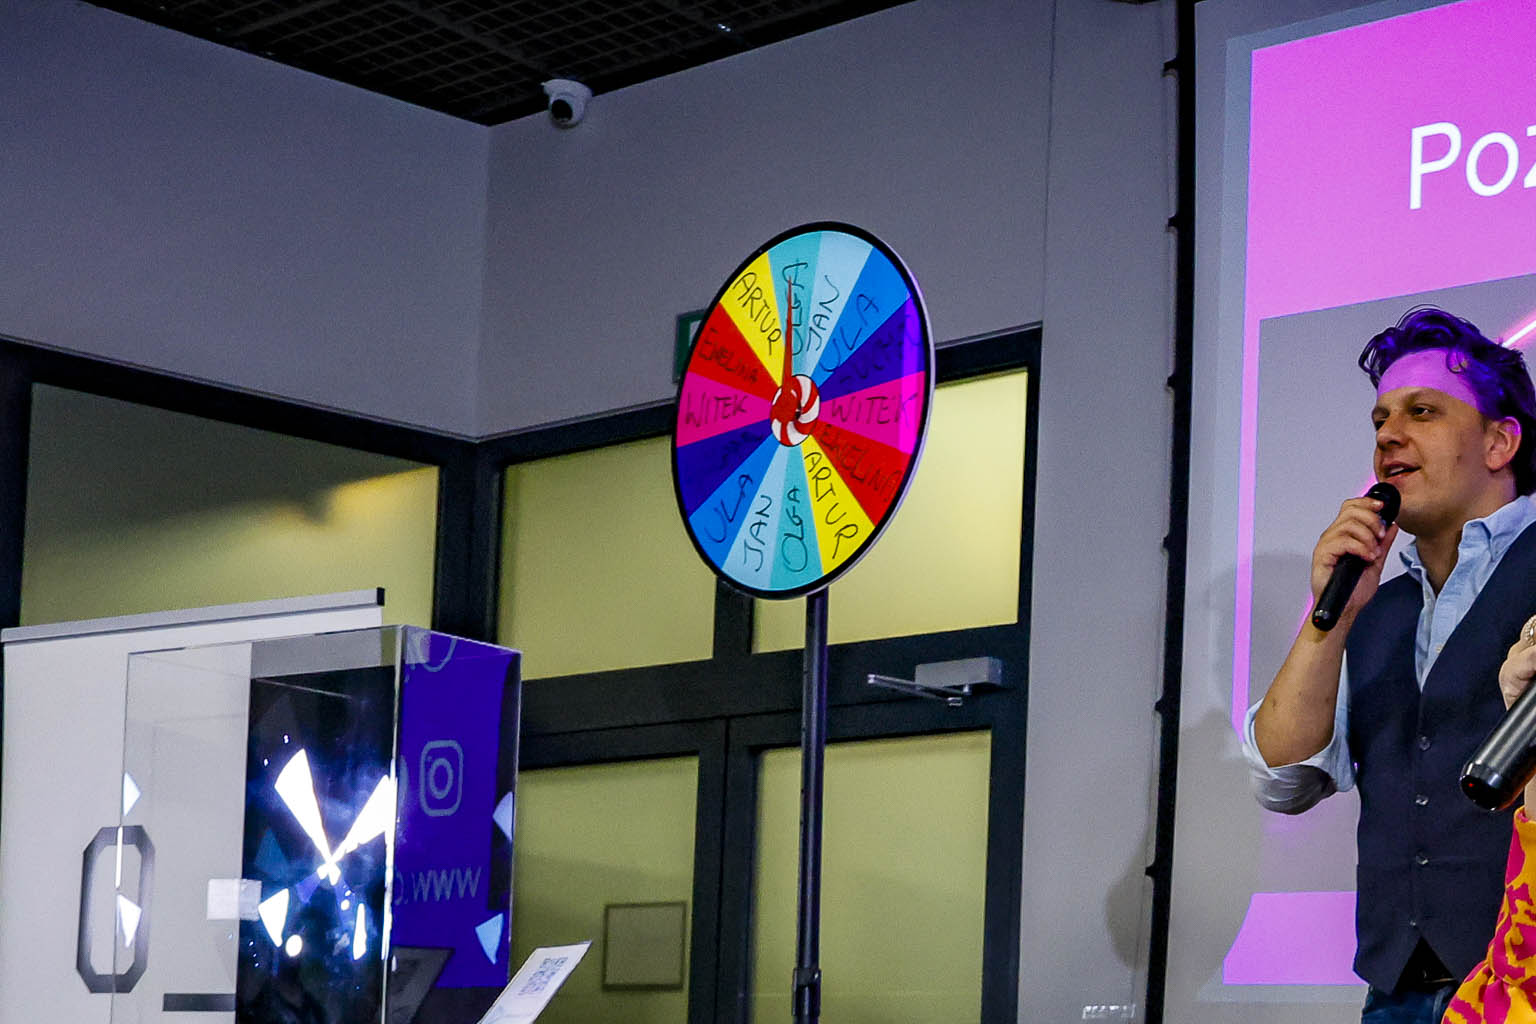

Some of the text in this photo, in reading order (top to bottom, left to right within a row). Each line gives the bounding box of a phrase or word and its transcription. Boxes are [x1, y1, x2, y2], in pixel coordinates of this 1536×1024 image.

[733, 271, 782, 355] ARTUR
[806, 275, 839, 351] JAN
[820, 294, 879, 372] ULA
[684, 392, 748, 428] WITEK
[830, 392, 919, 428] WITEK
[704, 474, 753, 543] ULA
[743, 494, 773, 572] JAN
[781, 488, 808, 573] OLGA
[803, 452, 858, 559] ARTUR
